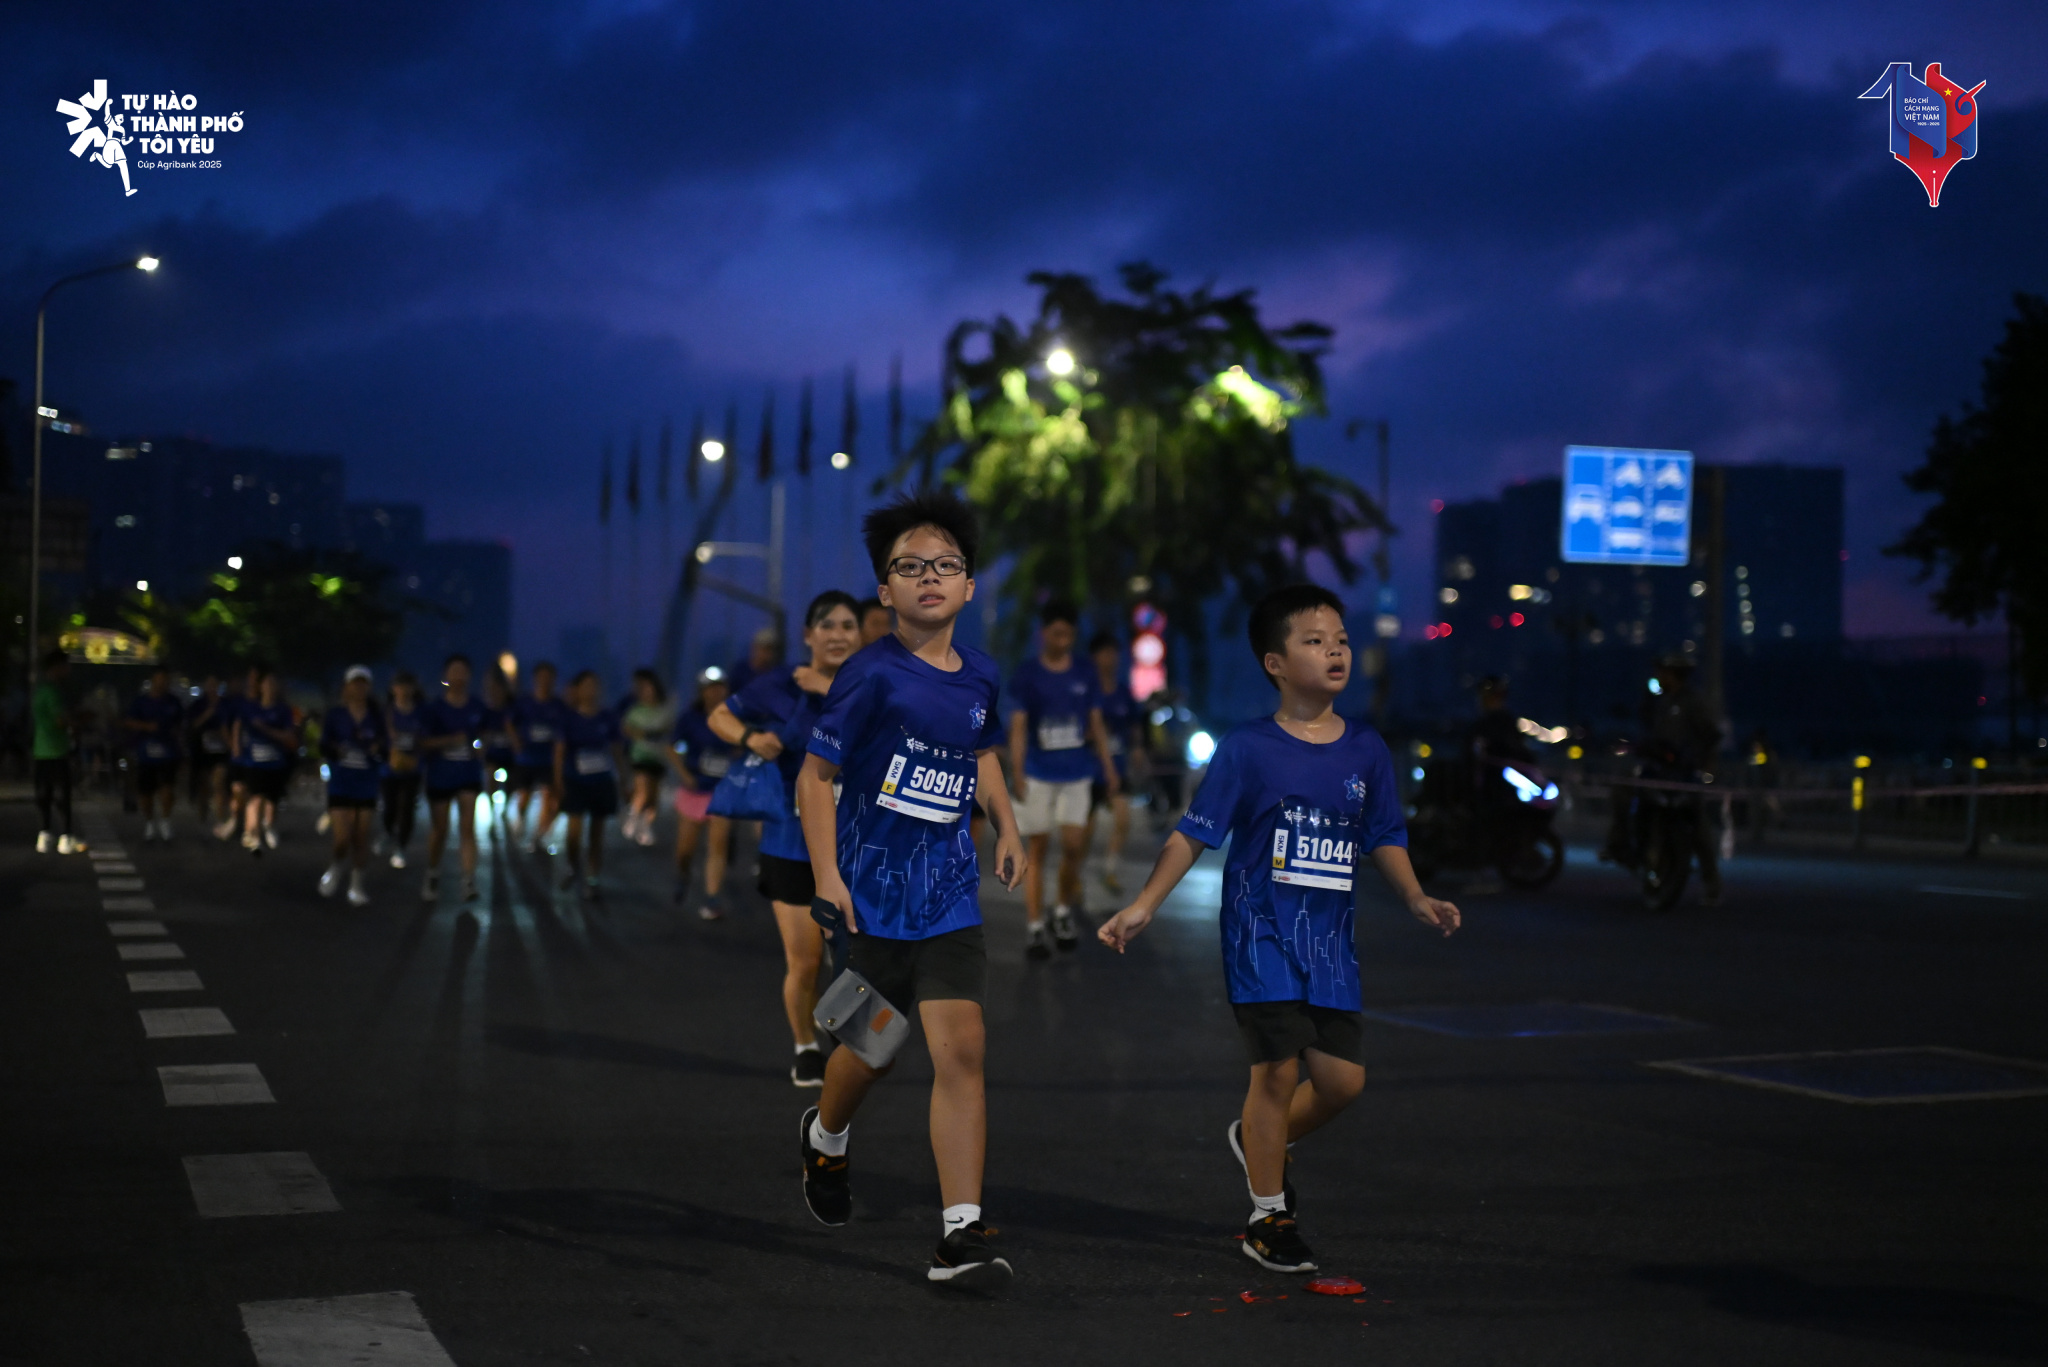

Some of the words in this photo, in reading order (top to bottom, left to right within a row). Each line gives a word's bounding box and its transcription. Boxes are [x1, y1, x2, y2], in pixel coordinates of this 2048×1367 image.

[890, 760, 902, 779] 5KM
[909, 765, 964, 798] 50914
[1277, 835, 1285, 853] 5KM
[1296, 835, 1353, 864] 51044
